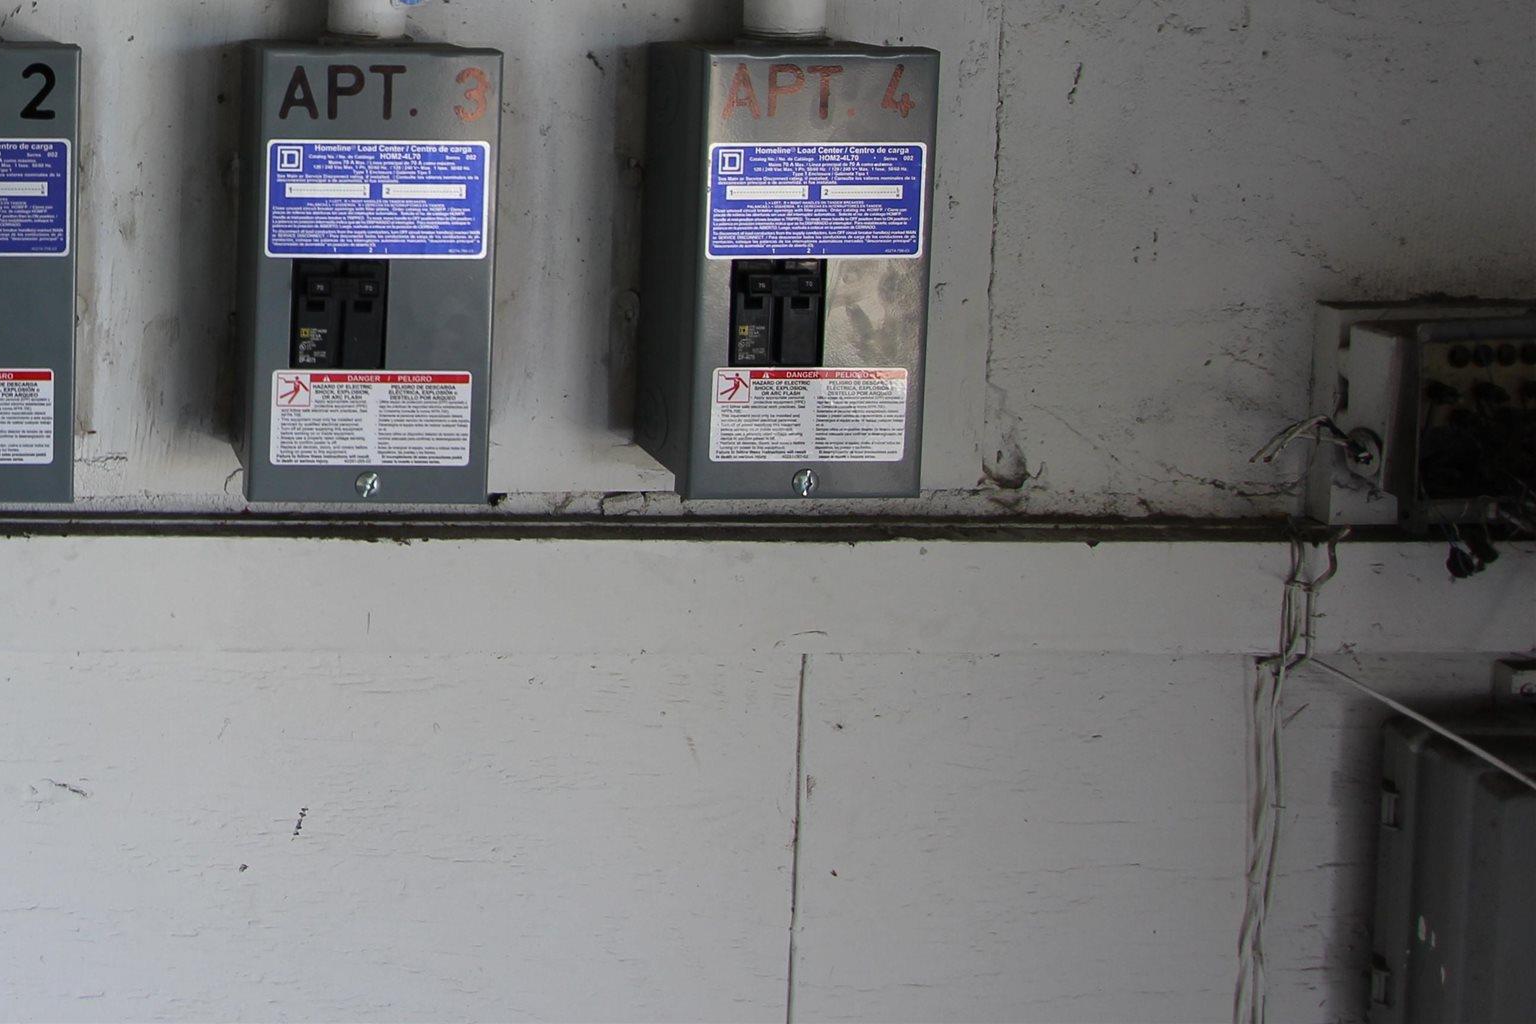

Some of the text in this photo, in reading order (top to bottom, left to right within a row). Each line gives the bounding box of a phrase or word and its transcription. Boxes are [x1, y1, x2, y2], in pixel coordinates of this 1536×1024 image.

[20, 63, 55, 119] 2
[279, 65, 491, 122] APT. 3
[721, 63, 915, 120] APT. 4
